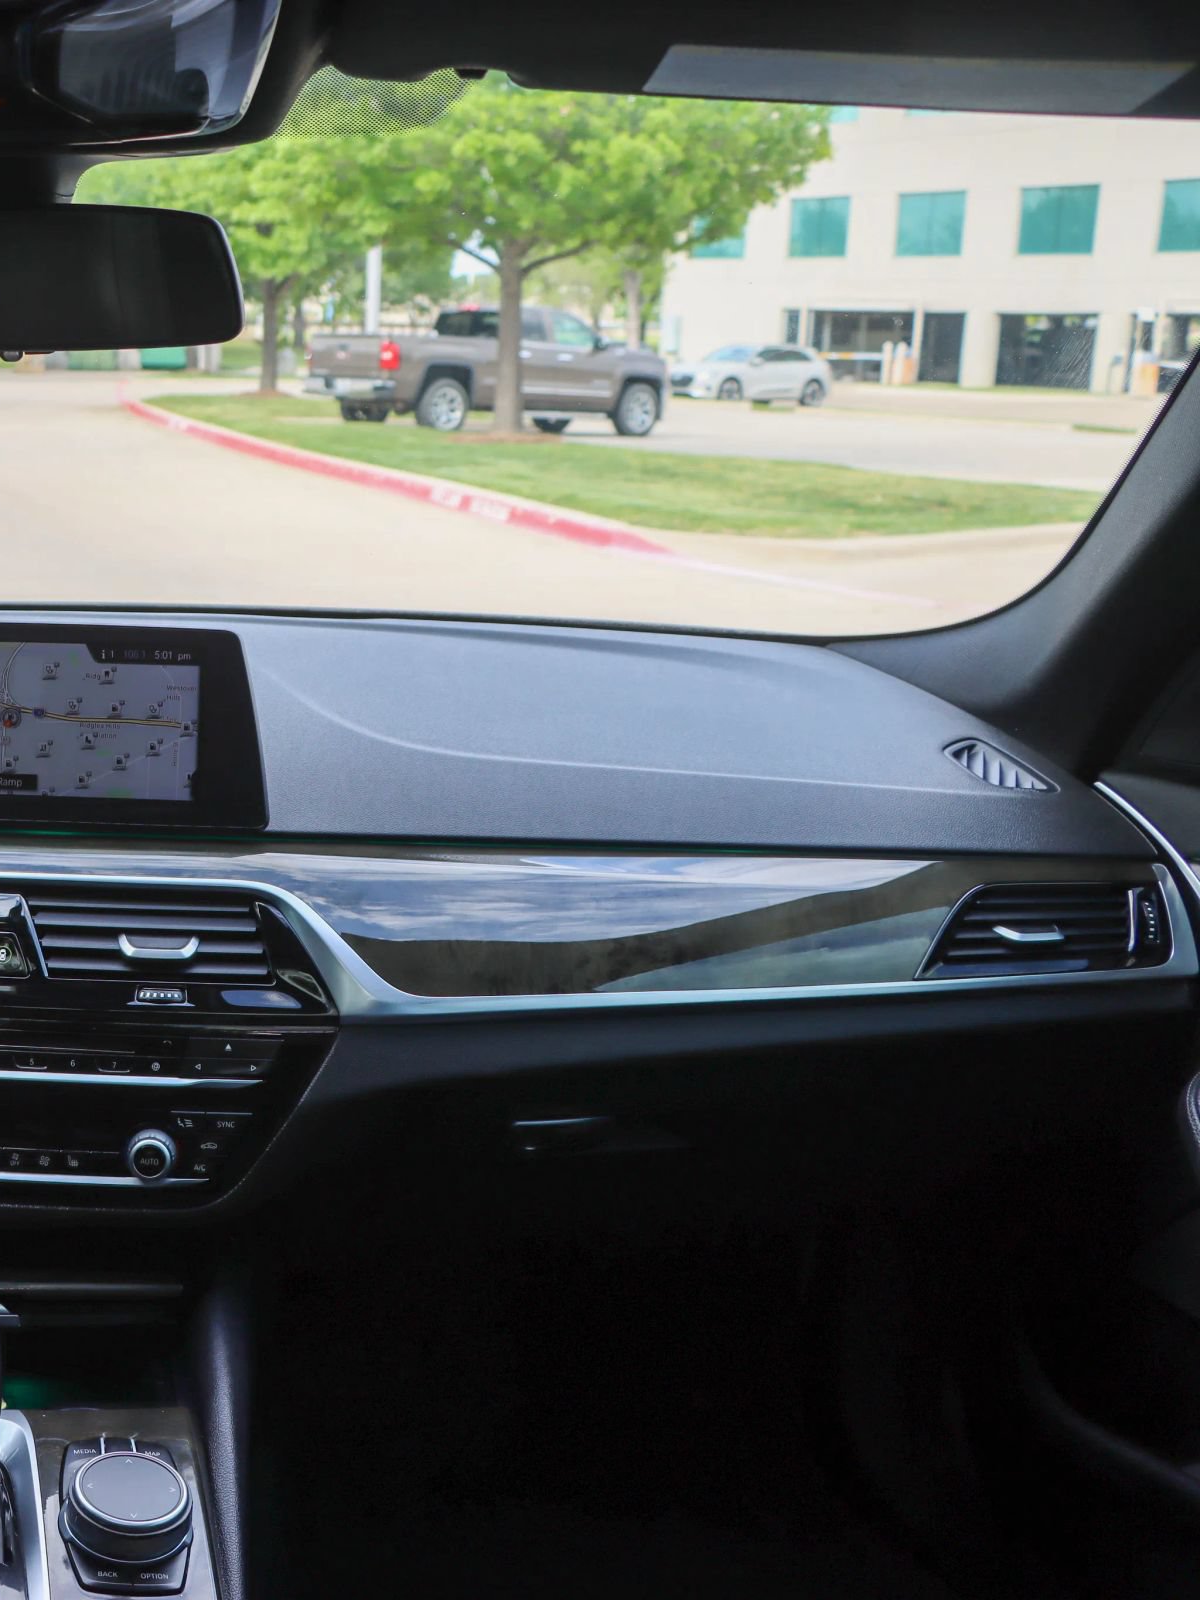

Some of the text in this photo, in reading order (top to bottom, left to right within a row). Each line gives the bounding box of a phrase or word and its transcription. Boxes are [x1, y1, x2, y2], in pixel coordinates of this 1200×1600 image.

[154, 650, 172, 660] 5:01
[177, 653, 191, 662] pm
[216, 1120, 236, 1129] SYNC
[140, 1158, 159, 1166] AUTO
[193, 1163, 206, 1172] A/C
[73, 1448, 97, 1456] MEDIA
[97, 1570, 169, 1580] BACK OPTION
